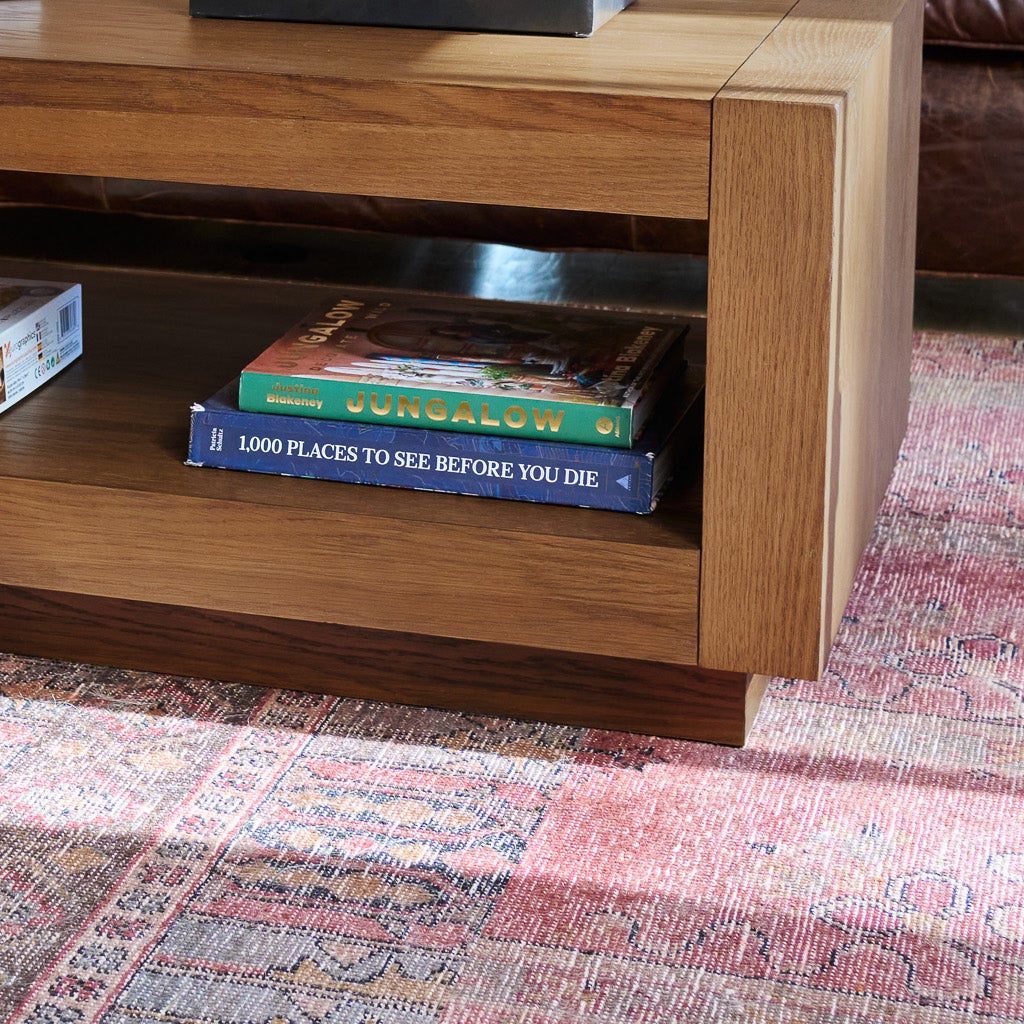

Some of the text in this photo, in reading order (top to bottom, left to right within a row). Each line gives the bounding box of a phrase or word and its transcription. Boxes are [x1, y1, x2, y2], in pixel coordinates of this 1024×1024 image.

[273, 299, 365, 368] JUNGALOW
[266, 393, 323, 410] Blakeney
[272, 382, 319, 395] Justina
[346, 391, 565, 433] JUNGALOW
[210, 427, 218, 451] Patricia
[238, 435, 599, 488] 1,000 PLACES TO SEE BEFORE YOU DIE
